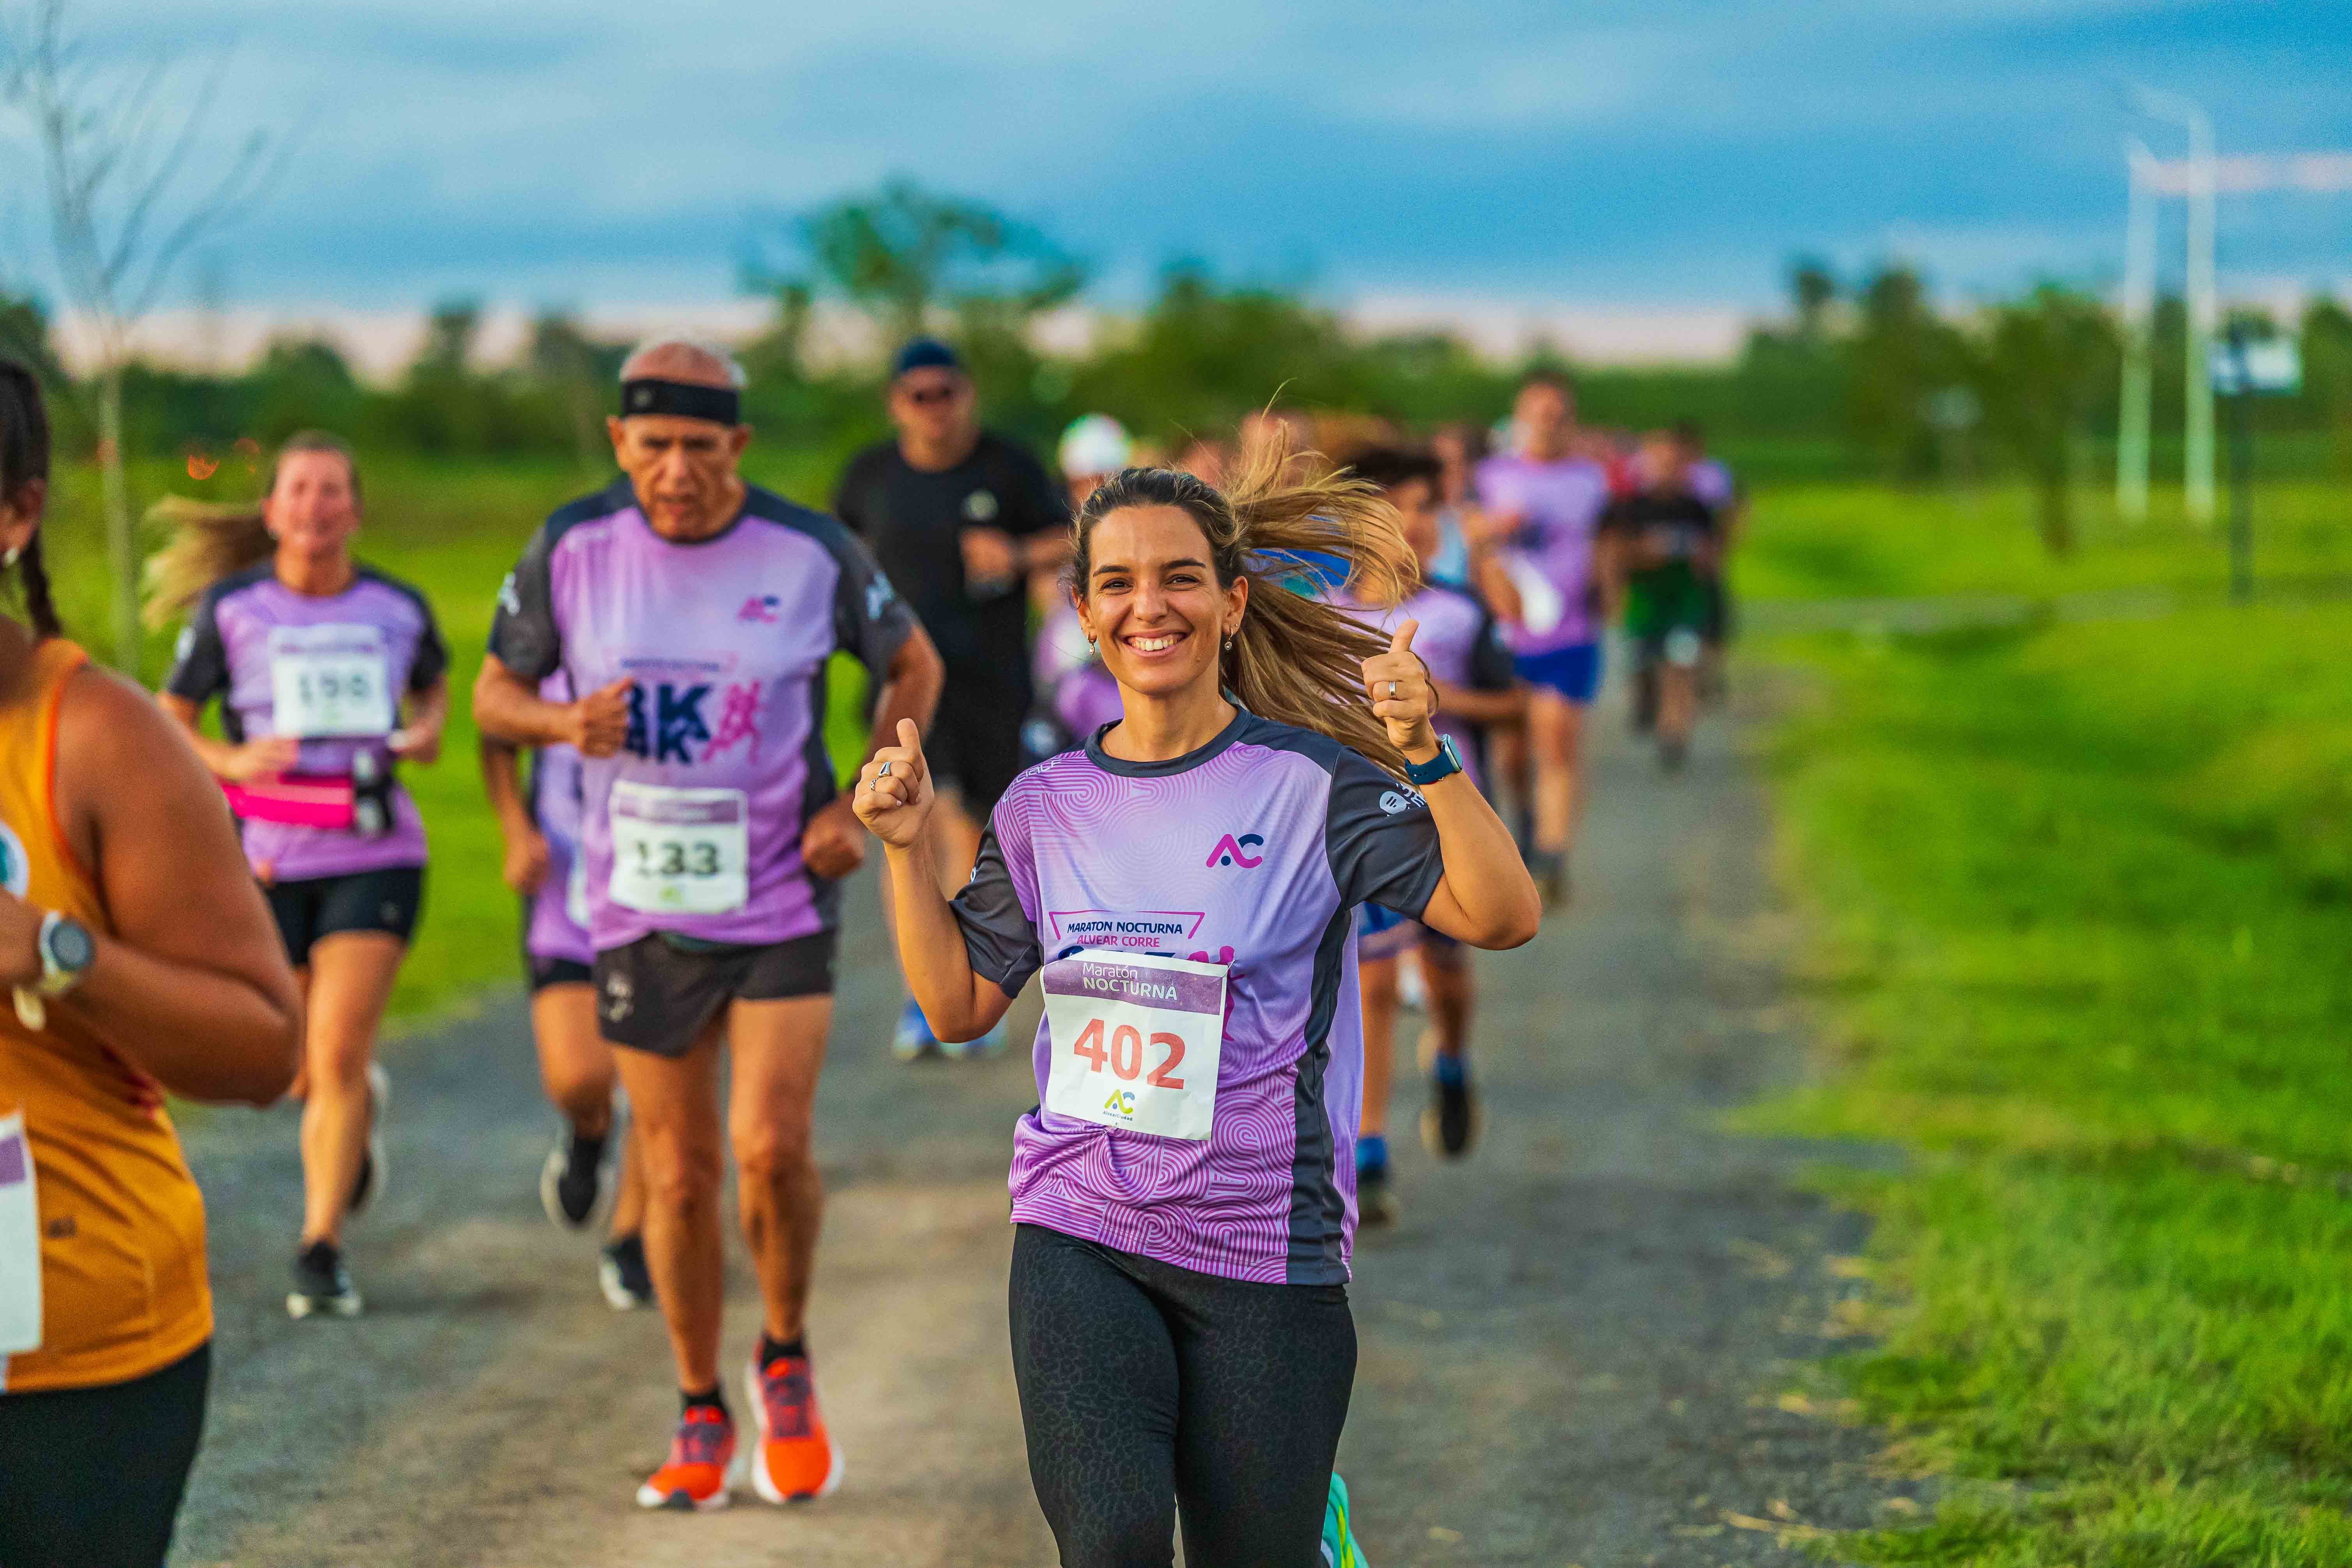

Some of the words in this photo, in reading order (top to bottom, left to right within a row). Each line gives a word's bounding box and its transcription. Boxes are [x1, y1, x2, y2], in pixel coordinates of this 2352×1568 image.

[636, 840, 721, 879] 133
[1068, 921, 1112, 933] MARATON
[1117, 921, 1183, 934] NOCTURNA
[1077, 935, 1118, 946] ALVEAR
[1121, 936, 1160, 947] CORRE
[1083, 963, 1138, 980] Maratón
[1083, 976, 1178, 1001] NOCTURNA
[1074, 1018, 1185, 1090] 402
